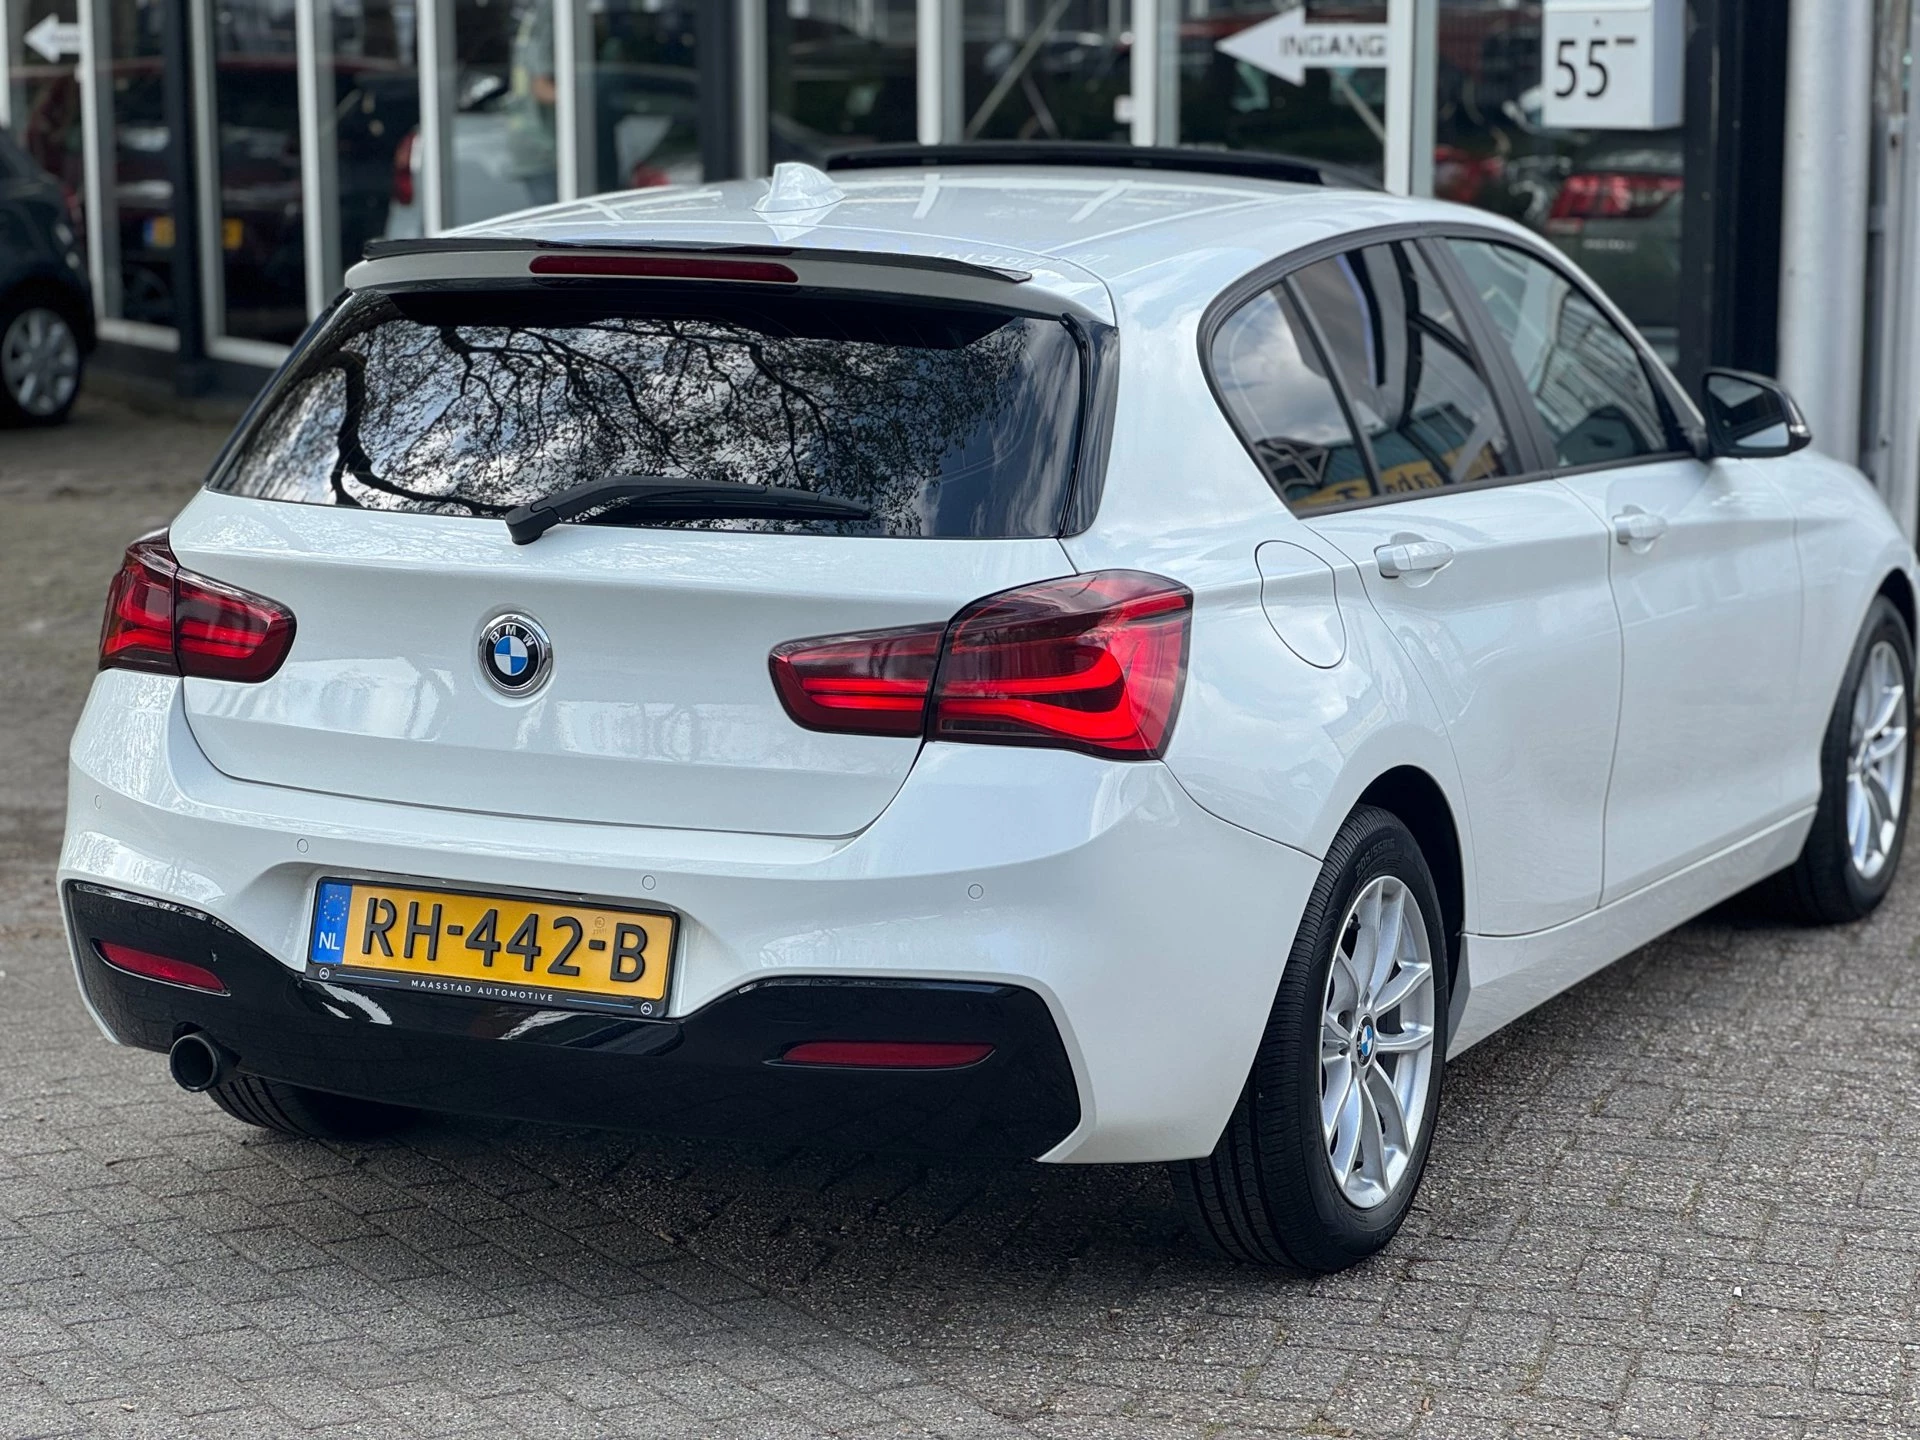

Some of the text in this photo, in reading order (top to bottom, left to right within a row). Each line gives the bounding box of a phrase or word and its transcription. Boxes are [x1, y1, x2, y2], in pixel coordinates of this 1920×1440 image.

[1281, 34, 1386, 58] INGANG
[489, 624, 535, 647] BMW
[318, 931, 341, 951] NL
[361, 897, 648, 983] RH-442-B
[411, 979, 553, 1002] MAASSTAD AUTOMOTIVE
